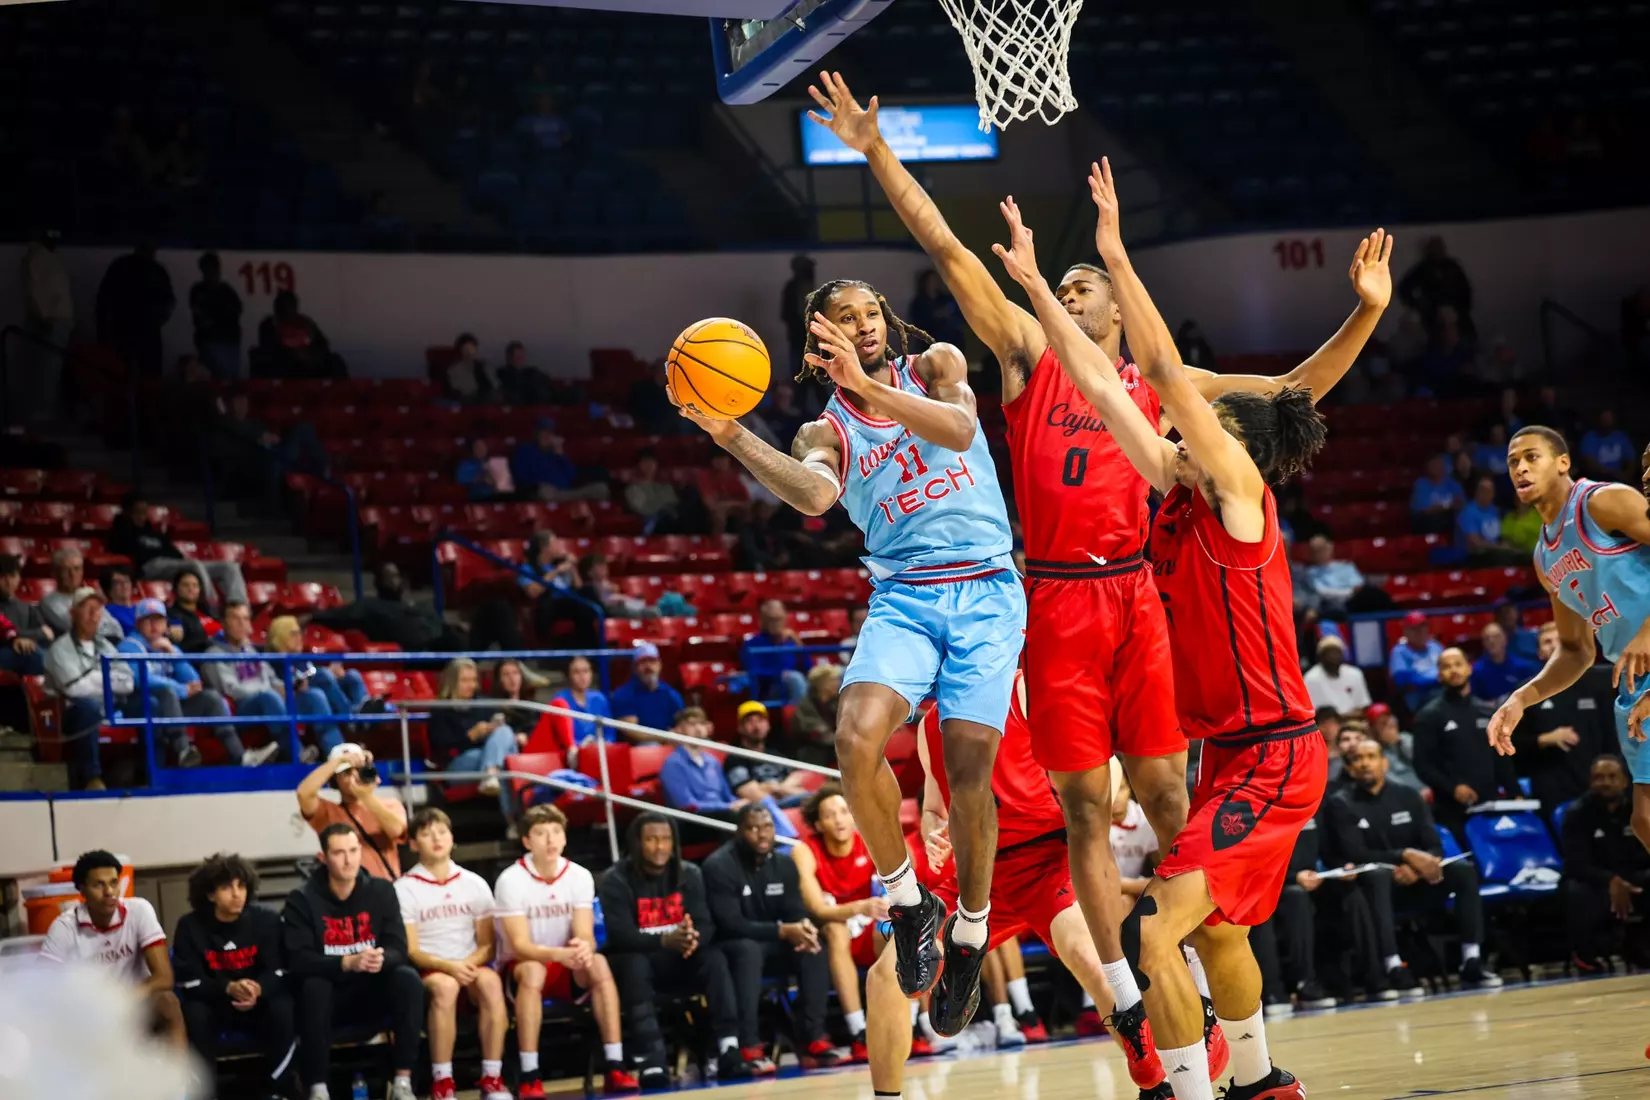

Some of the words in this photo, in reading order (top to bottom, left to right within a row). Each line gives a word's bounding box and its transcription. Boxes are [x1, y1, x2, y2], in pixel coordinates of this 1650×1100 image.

[1272, 237, 1324, 271] 101
[237, 261, 295, 296] 119
[1047, 403, 1108, 437] Cajun
[894, 443, 928, 484] 11
[1062, 447, 1090, 487] 0
[878, 455, 976, 524] TECH
